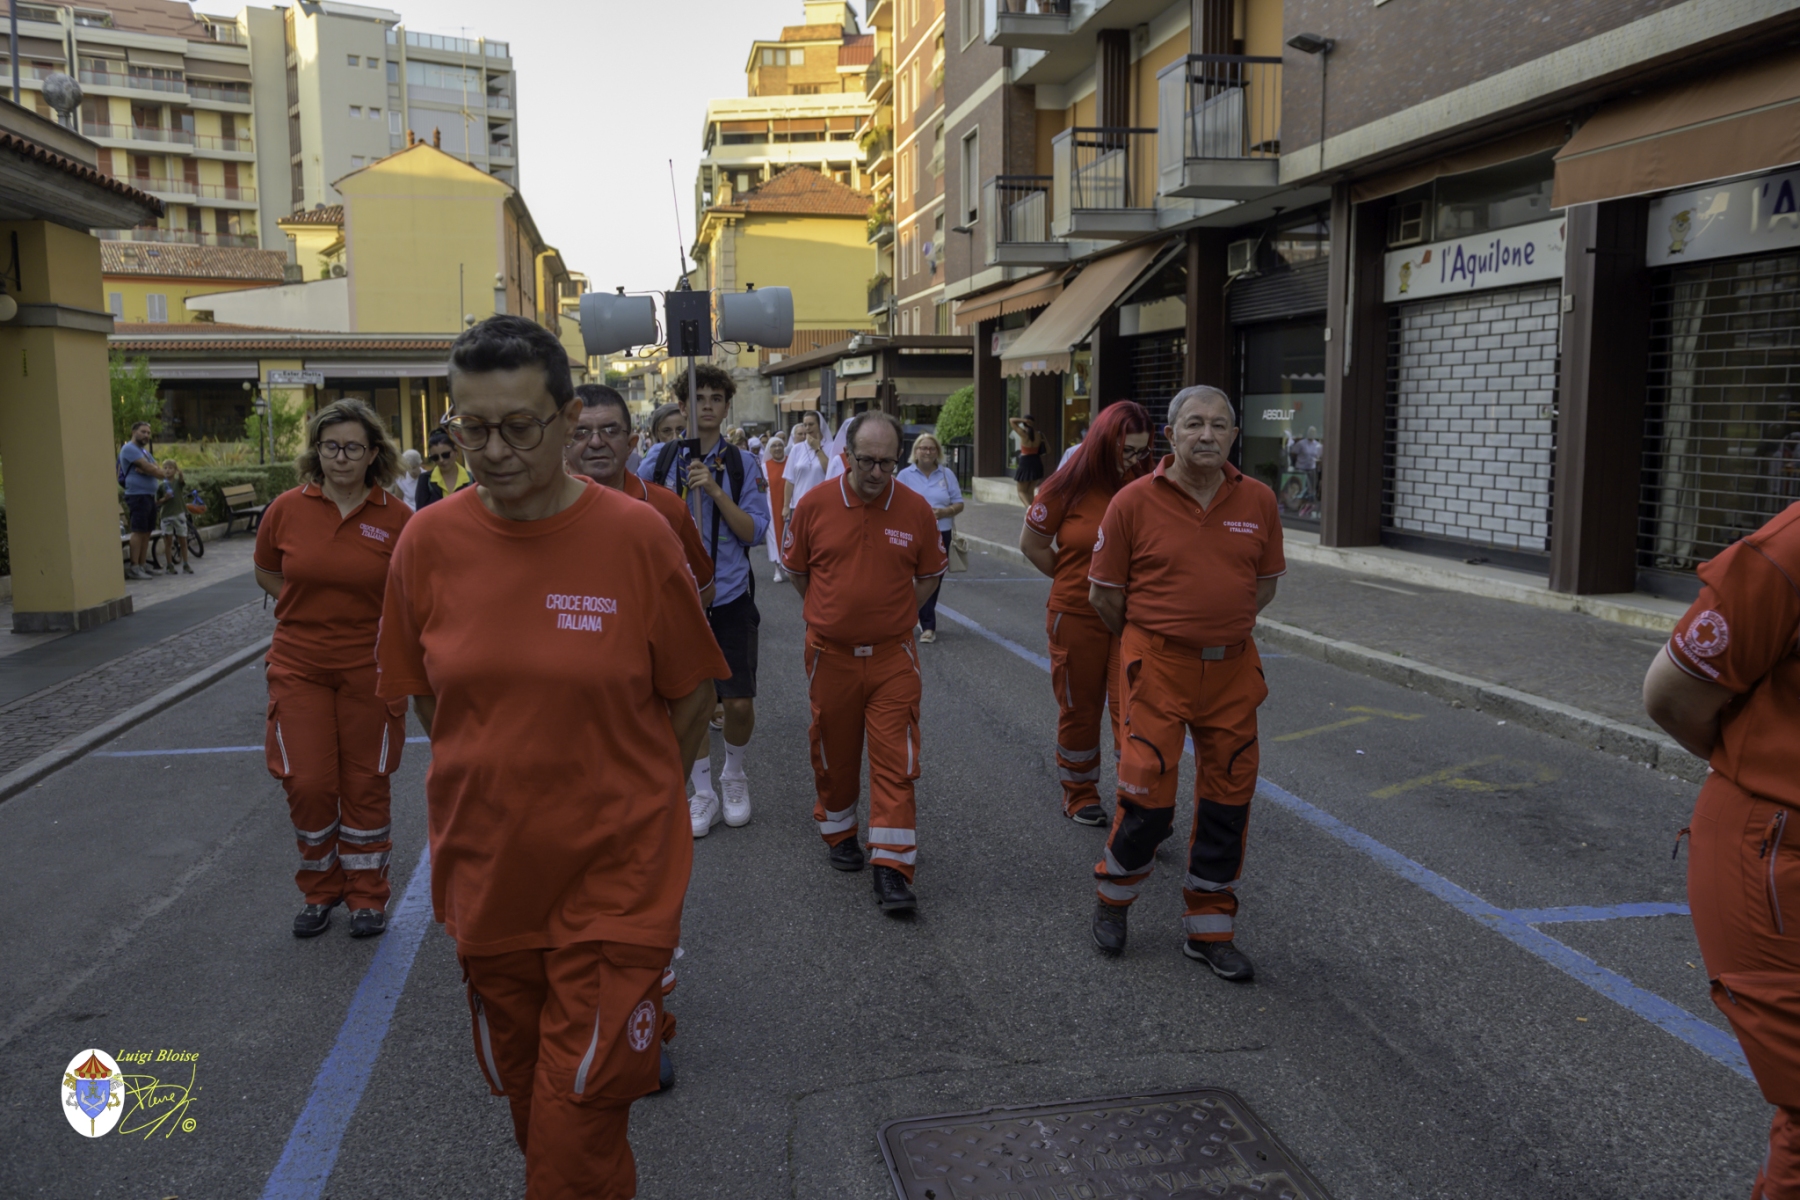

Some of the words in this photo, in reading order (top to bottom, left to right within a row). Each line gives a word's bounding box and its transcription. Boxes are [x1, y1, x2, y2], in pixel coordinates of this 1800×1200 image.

[1750, 178, 1800, 233] l'A
[1441, 238, 1535, 288] l'Aquilone
[1262, 409, 1296, 420] ABSOLUT
[1229, 526, 1254, 534] ITALIANA
[1242, 521, 1259, 529] ROSSA
[884, 528, 900, 538] CROCE
[899, 531, 913, 542] ROSSA
[546, 593, 582, 611] CROCE
[582, 595, 617, 614] ROSSA
[557, 613, 603, 632] ITALIANA
